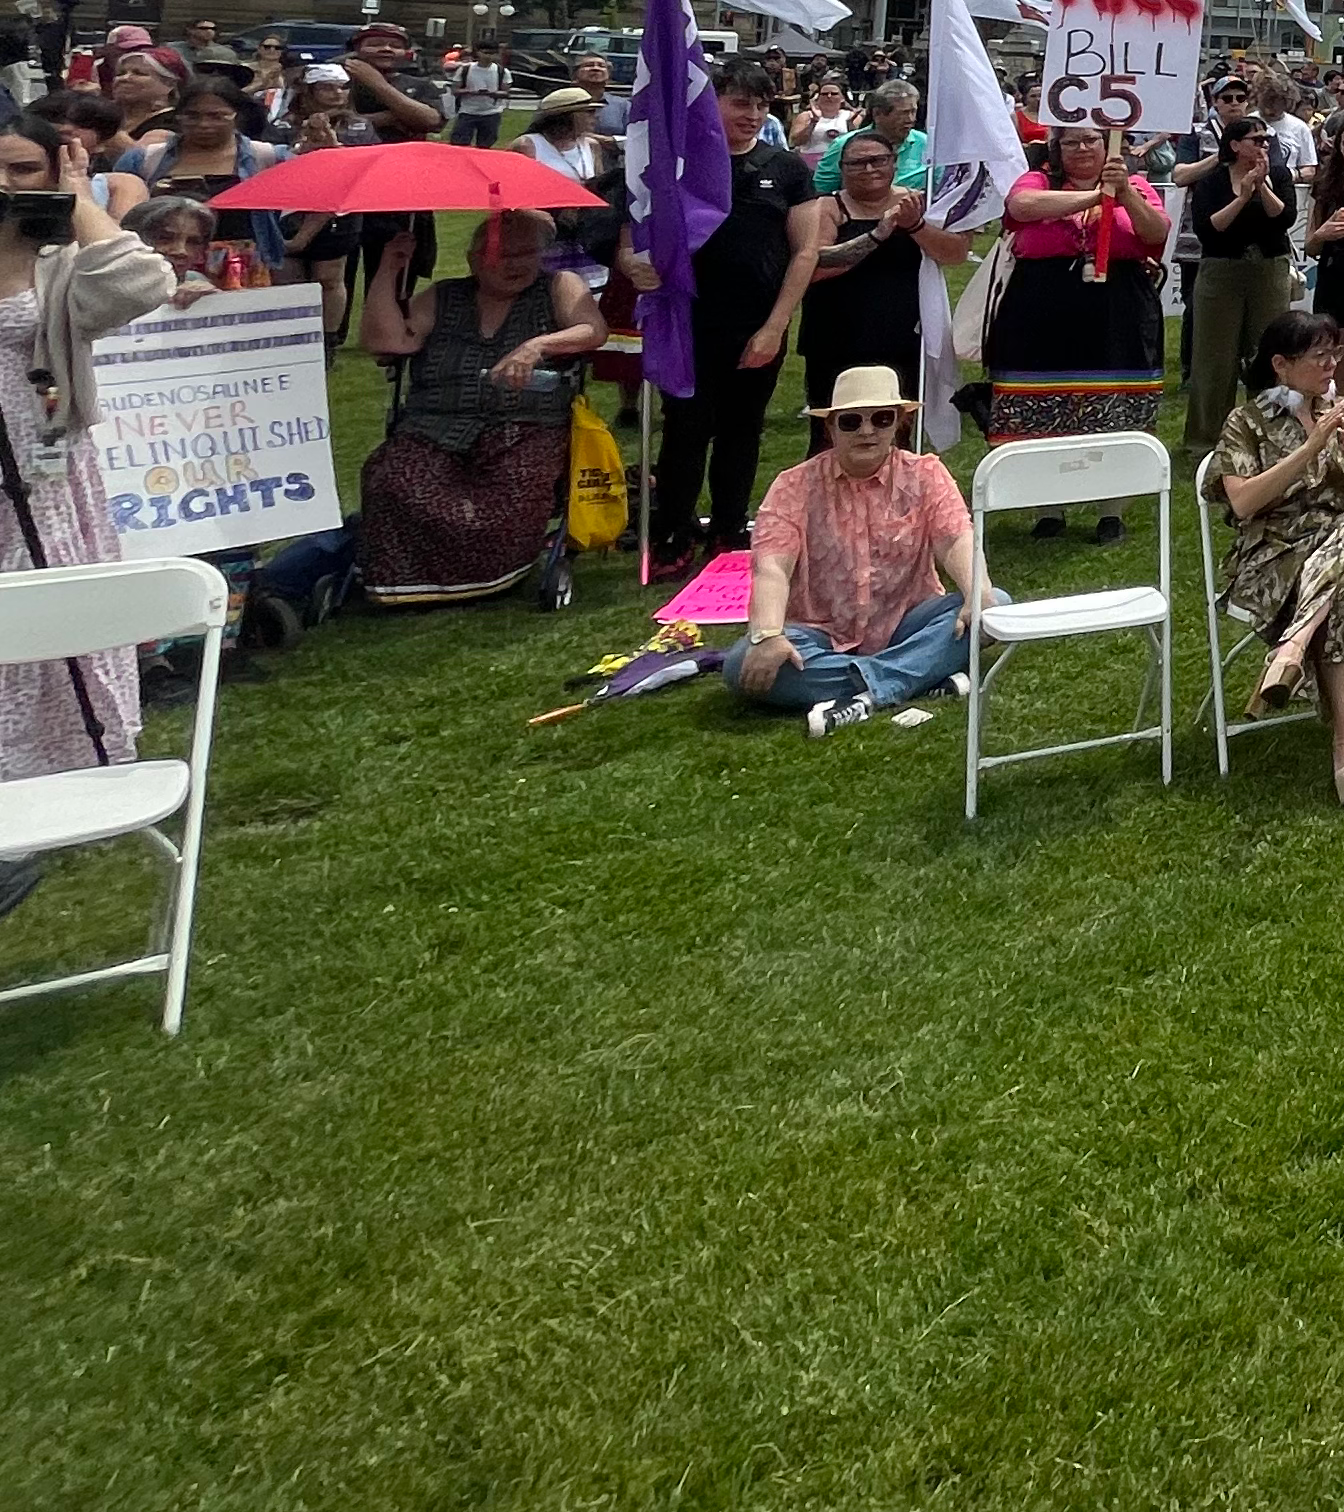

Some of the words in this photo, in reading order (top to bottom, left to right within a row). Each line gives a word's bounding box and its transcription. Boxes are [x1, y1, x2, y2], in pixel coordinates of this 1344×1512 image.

[1065, 29, 1178, 77] BILL
[1048, 74, 1143, 128] C5
[97, 373, 292, 413] AUDENOSAUNEE
[101, 415, 330, 472] ELINQUISHED
[114, 399, 255, 441] NEVER
[143, 452, 259, 495] OUR
[105, 472, 316, 534] RIGHTS
